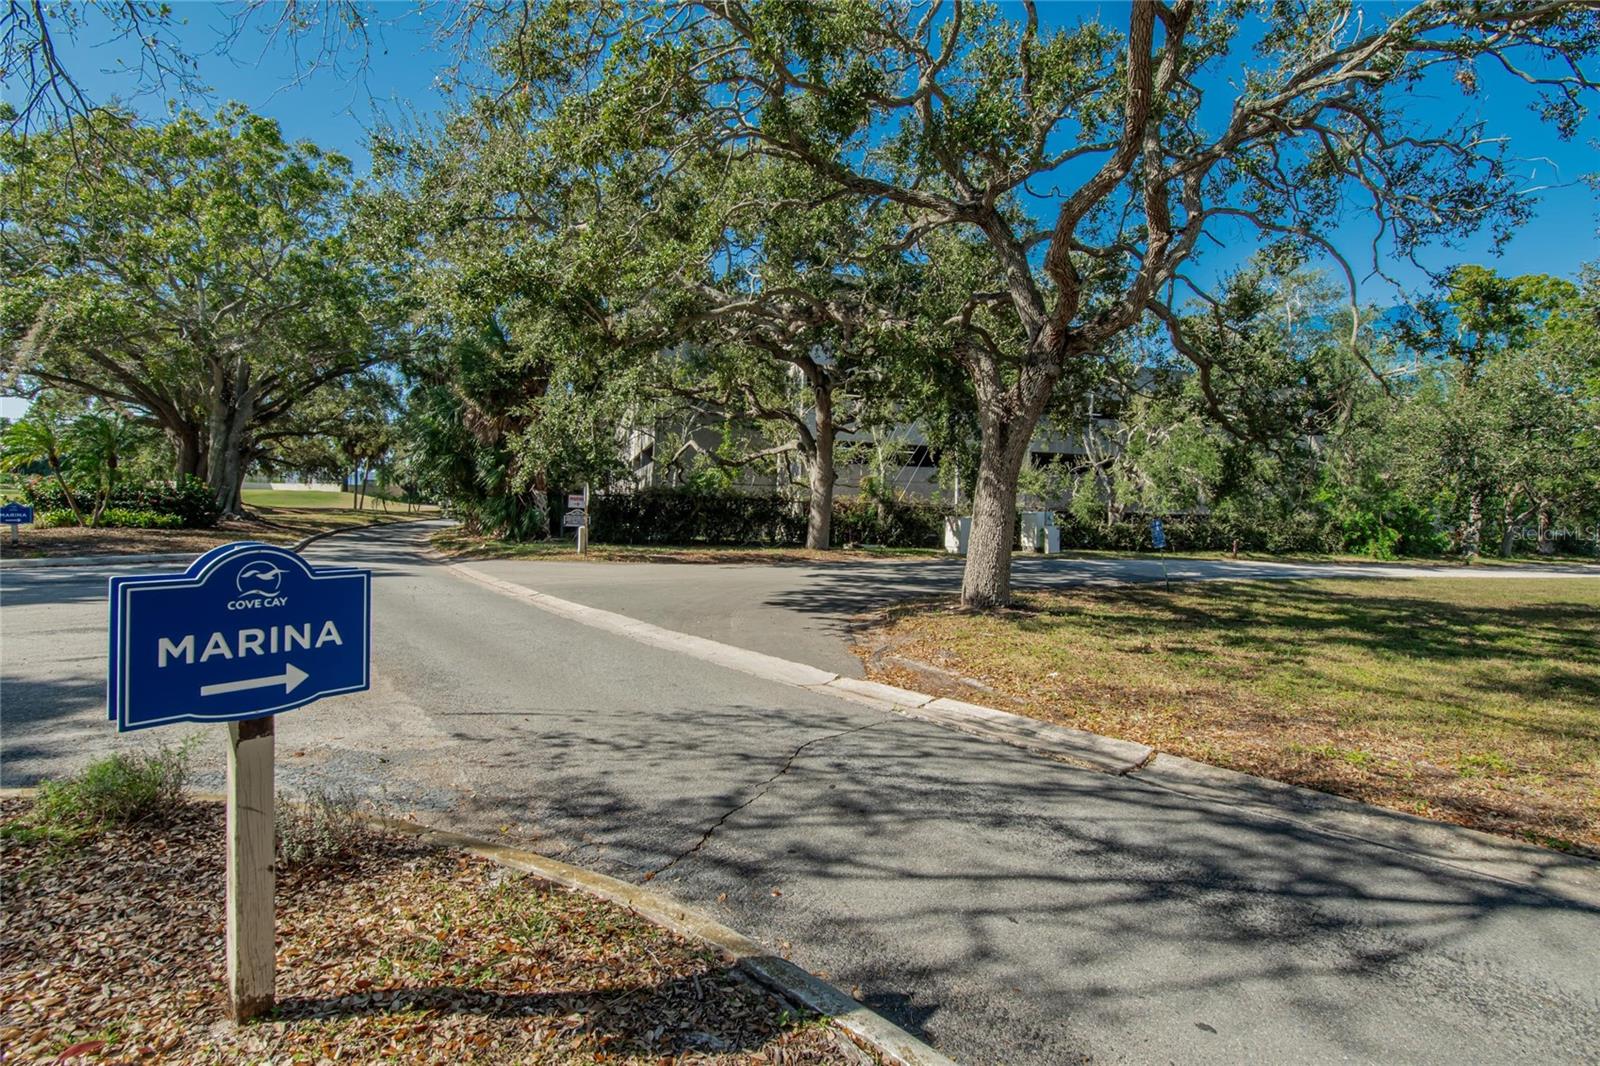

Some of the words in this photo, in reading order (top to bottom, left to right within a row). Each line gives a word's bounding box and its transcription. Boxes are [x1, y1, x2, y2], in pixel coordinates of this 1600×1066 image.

[227, 599, 262, 610] COVE
[264, 596, 289, 608] CAY
[158, 620, 343, 668] MARINA
